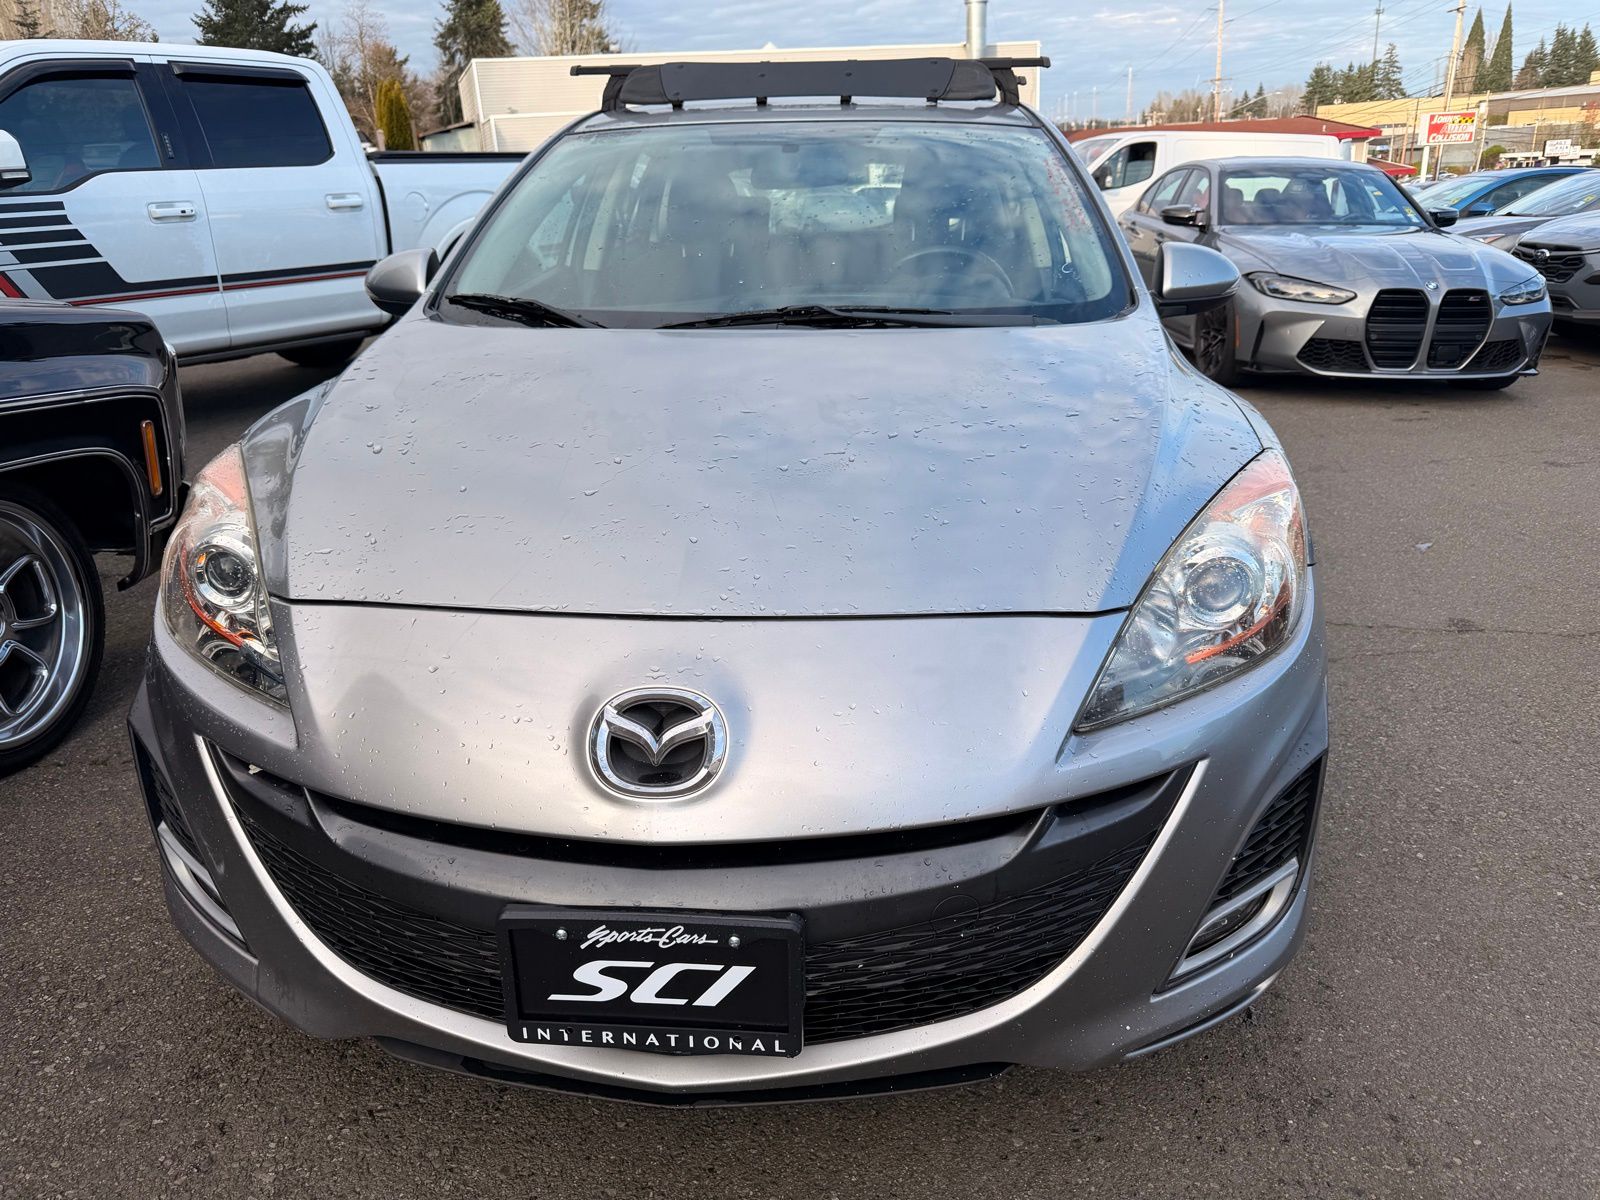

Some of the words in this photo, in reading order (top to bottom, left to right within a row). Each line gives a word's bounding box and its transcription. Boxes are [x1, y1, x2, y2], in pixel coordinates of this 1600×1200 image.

[1429, 133, 1470, 143] COLLISION
[580, 925, 661, 949] Sports
[659, 925, 718, 949] Cars
[547, 960, 756, 1007] SCI
[522, 1027, 786, 1053] INTERNATIONAL
